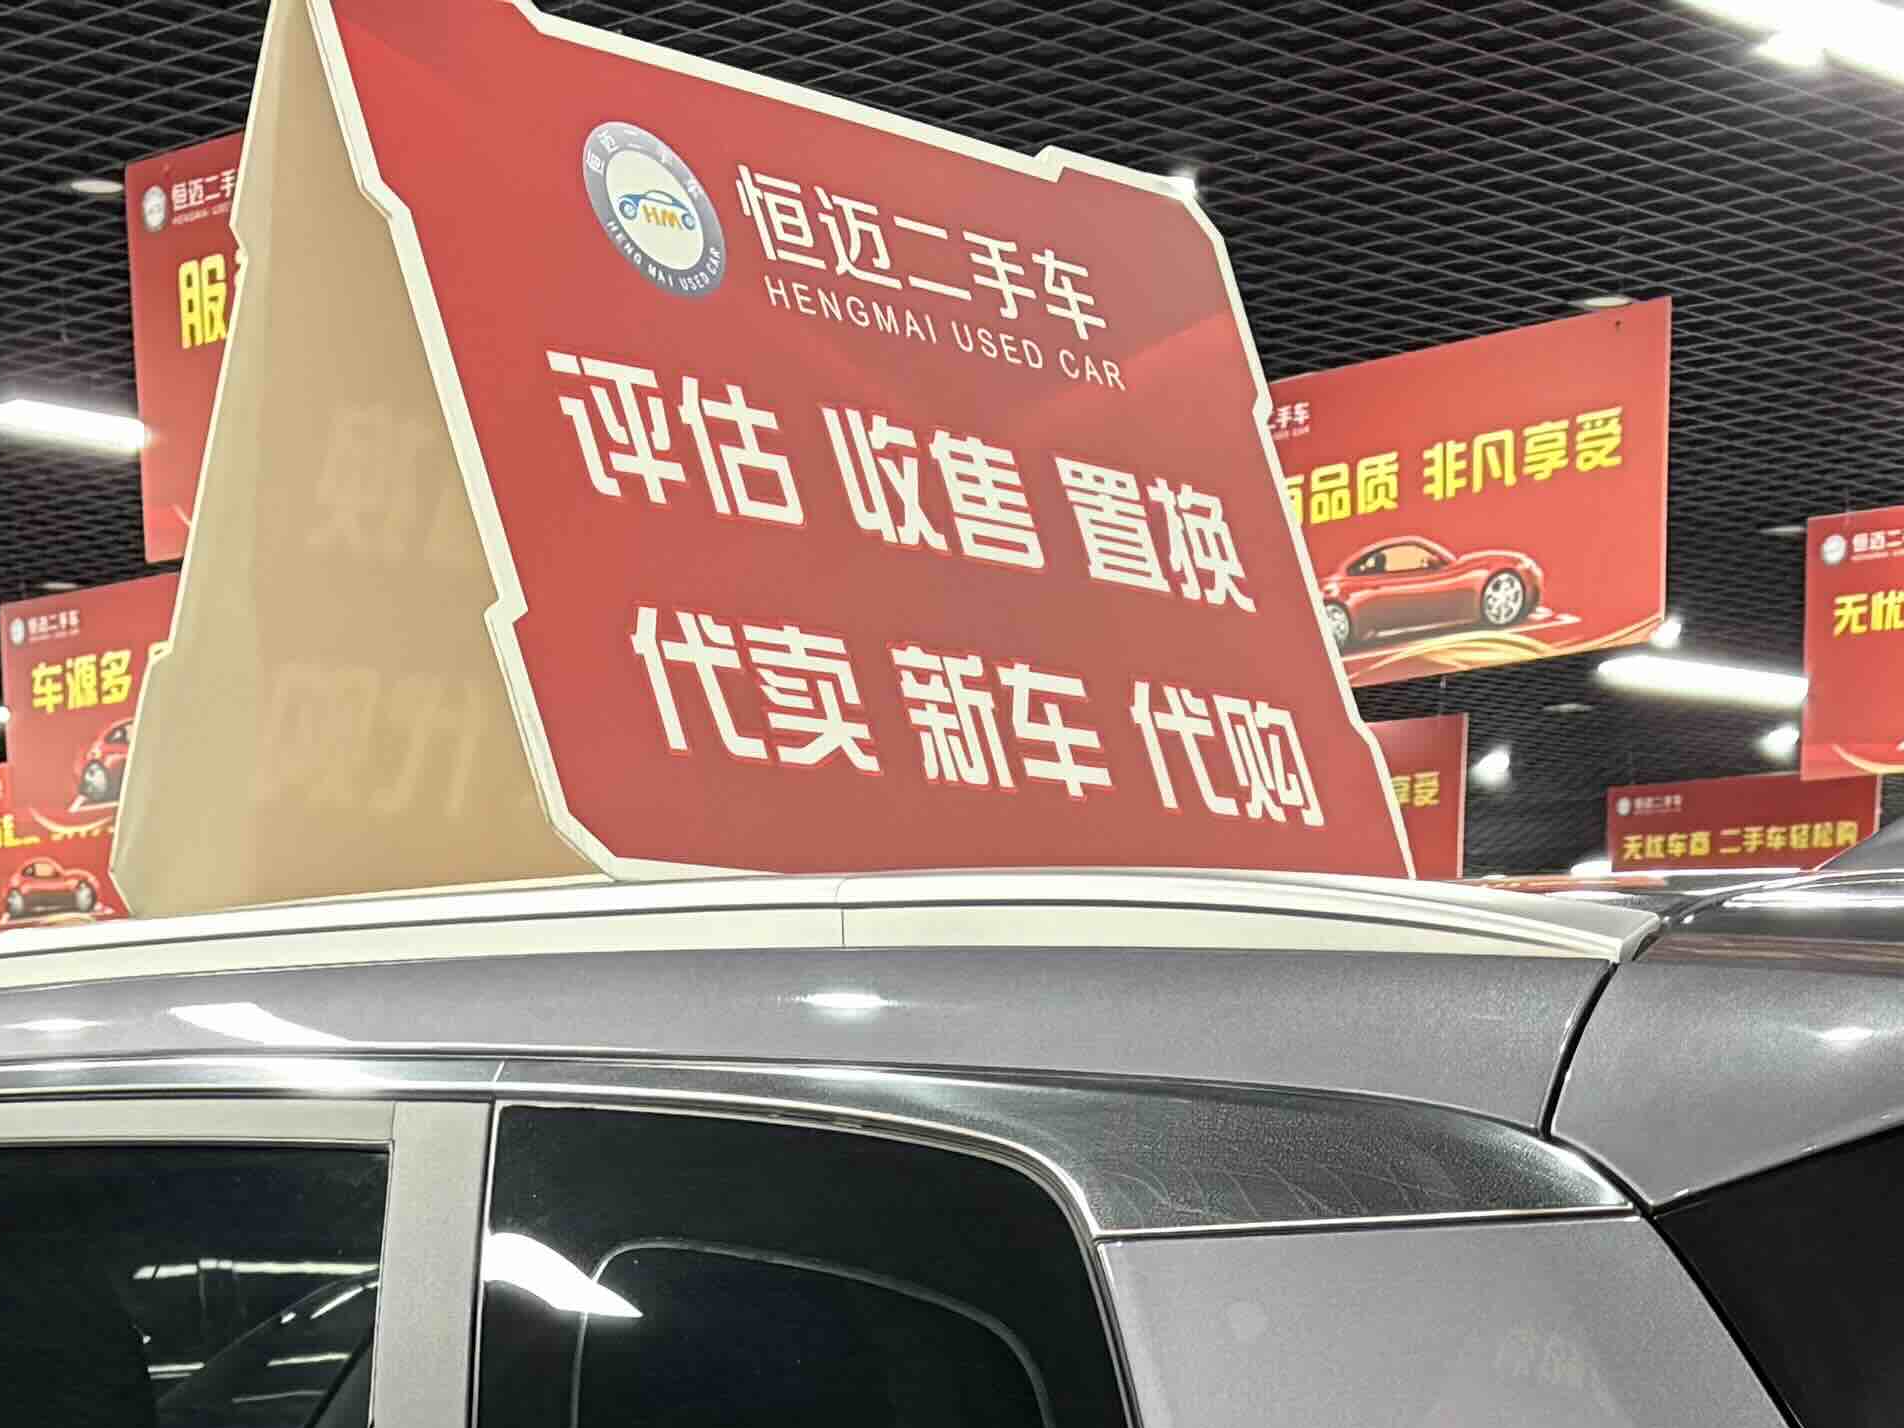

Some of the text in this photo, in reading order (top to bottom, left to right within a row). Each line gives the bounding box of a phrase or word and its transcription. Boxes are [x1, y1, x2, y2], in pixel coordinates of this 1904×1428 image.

[179, 248, 246, 350] 服
[736, 164, 1107, 340] 恒迈二手车
[764, 276, 1127, 391] HENGMAI USED CAR
[547, 351, 1257, 612] 评估 收售 置换
[1422, 406, 1623, 501] 非凡享受
[31, 649, 132, 714] 车源多
[631, 606, 1324, 828] 代卖 新车 代购
